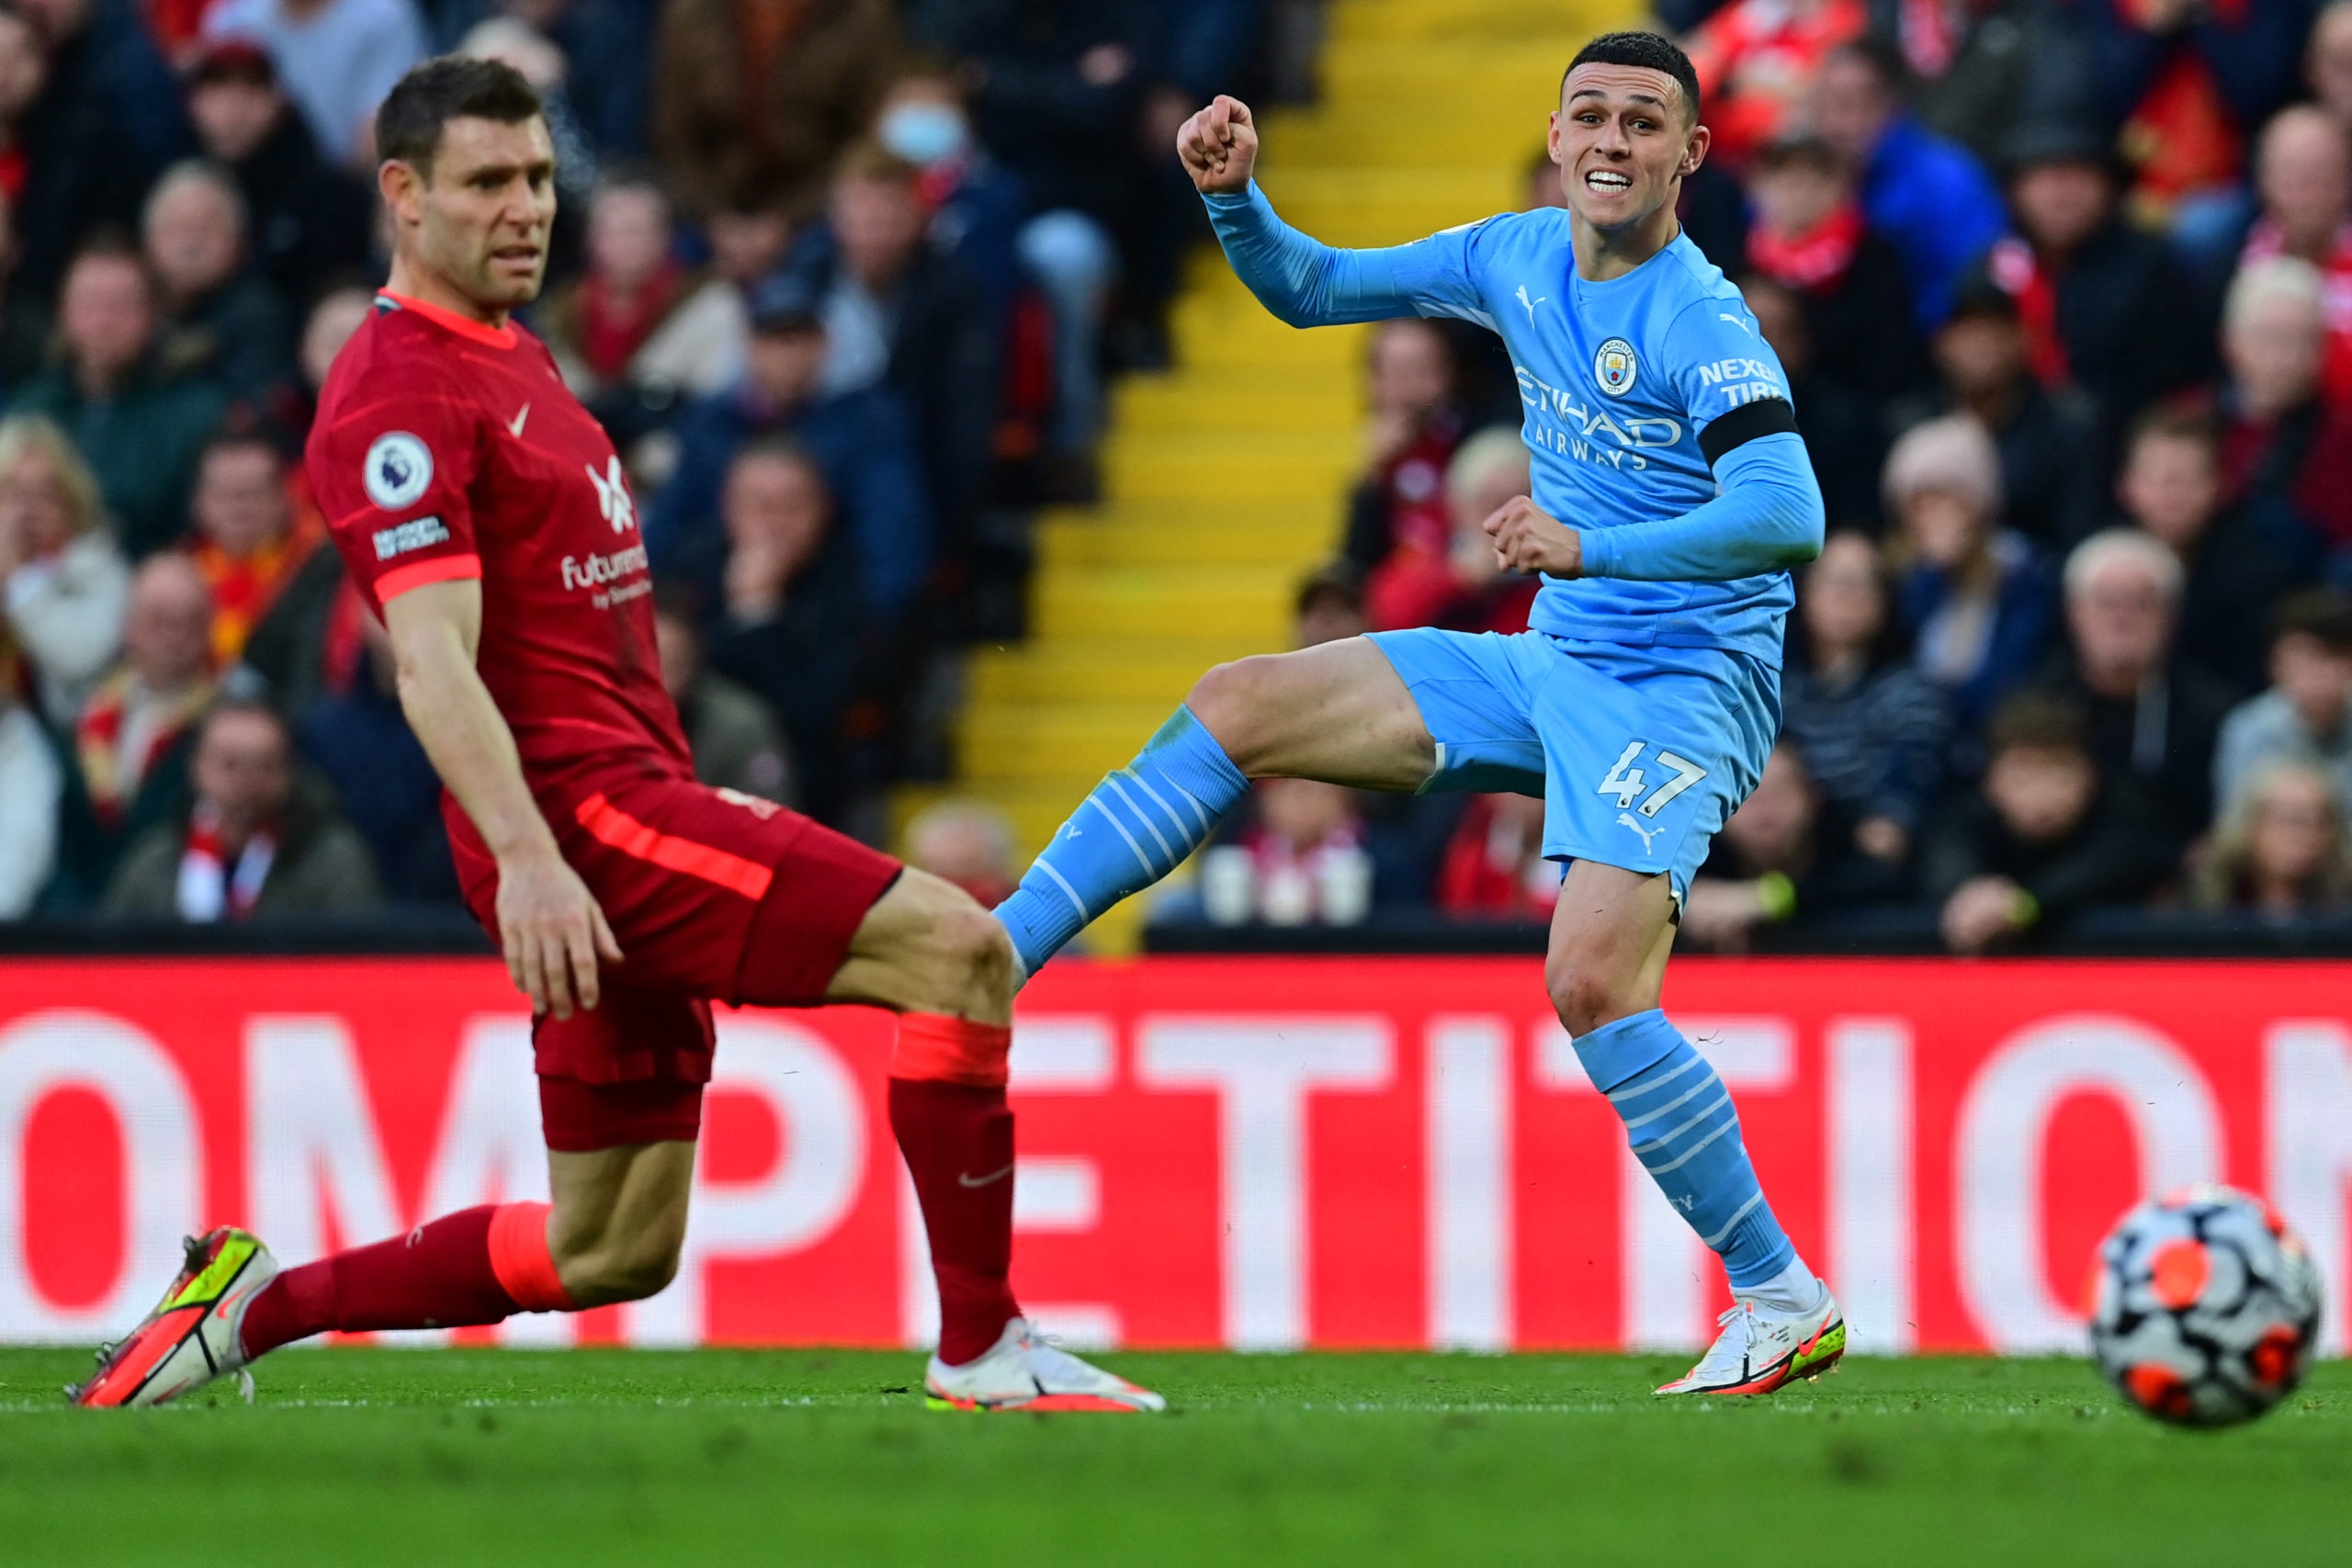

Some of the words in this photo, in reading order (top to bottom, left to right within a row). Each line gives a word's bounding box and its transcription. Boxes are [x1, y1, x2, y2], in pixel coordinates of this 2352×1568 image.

[1599, 341, 1634, 362] MANCHESTER
[1515, 366, 1682, 448] ETIHAD
[1596, 740, 1708, 819] 47
